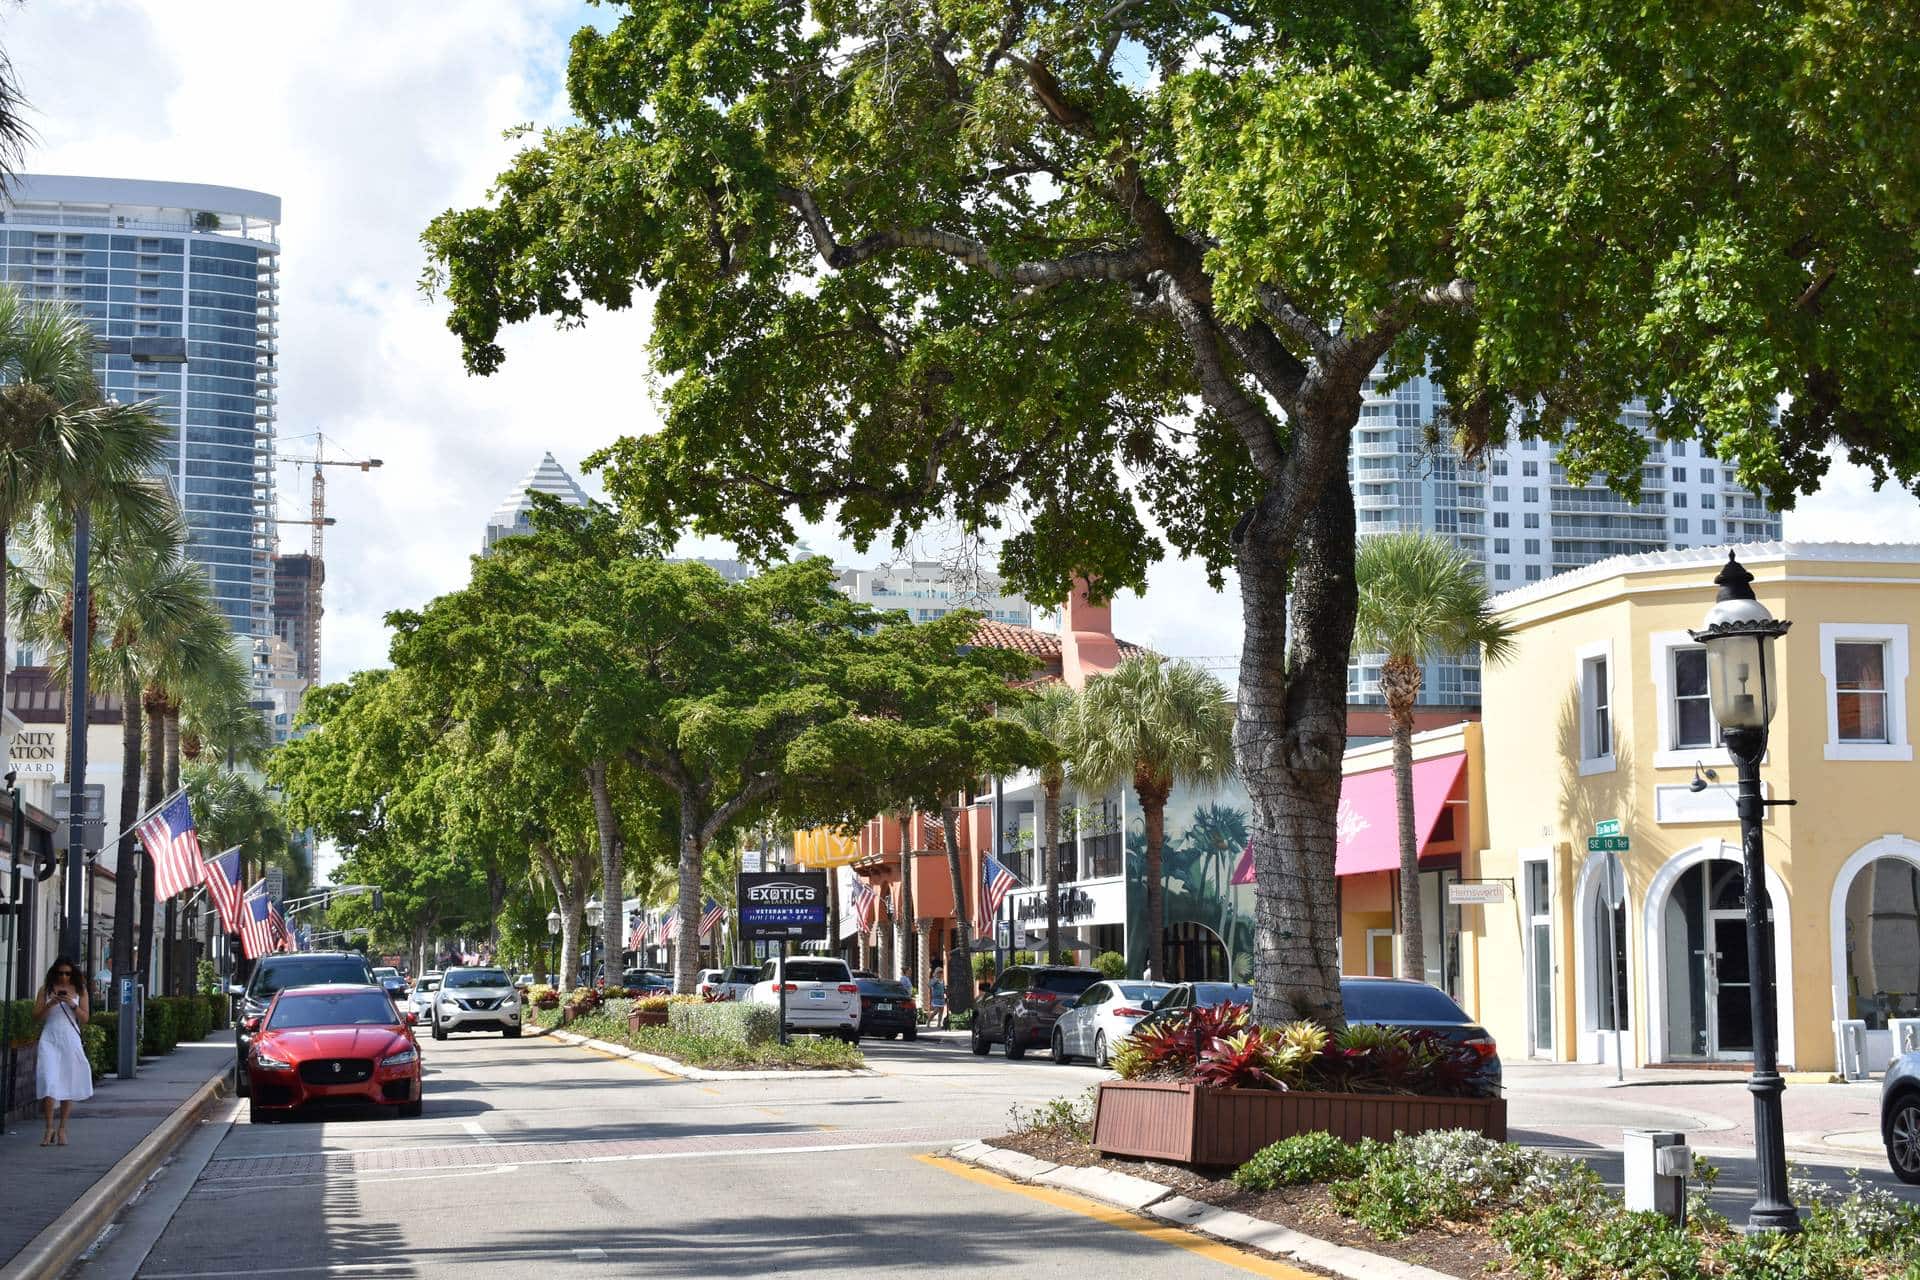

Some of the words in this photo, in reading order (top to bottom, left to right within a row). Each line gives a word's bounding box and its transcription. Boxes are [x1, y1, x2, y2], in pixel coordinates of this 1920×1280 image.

[1590, 839, 1600, 849] SE
[1604, 839, 1613, 849] 10
[750, 889, 816, 900] EXOTICS
[124, 981, 132, 991] P
